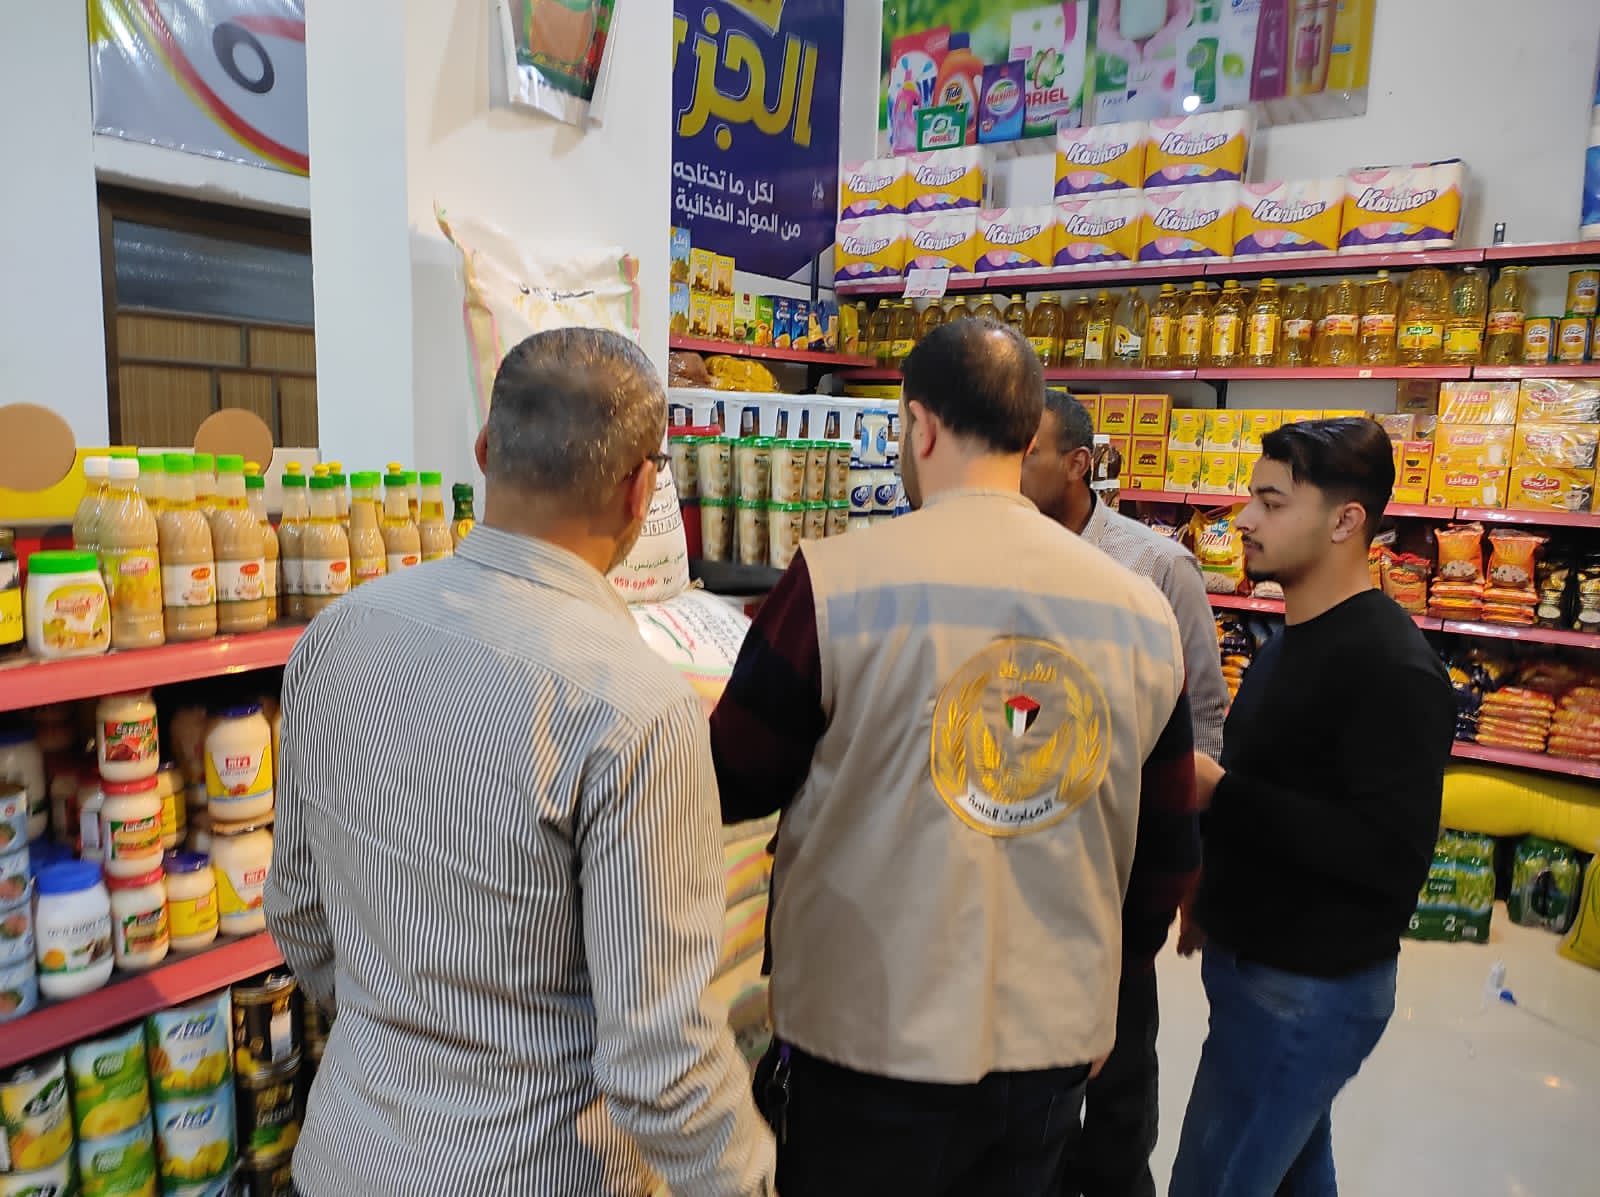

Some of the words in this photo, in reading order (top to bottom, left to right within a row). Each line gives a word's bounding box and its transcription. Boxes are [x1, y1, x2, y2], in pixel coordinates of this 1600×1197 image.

[945, 86, 962, 101] Tide
[1025, 88, 1069, 106] ARIEL
[929, 133, 953, 144] ARIEL
[1160, 132, 1228, 155] Karmen
[1067, 142, 1128, 165] Karmen
[673, 161, 726, 190] تحتاجه
[729, 173, 744, 195] ما
[848, 174, 893, 193] Karmen
[915, 165, 967, 186] Karmen
[748, 180, 774, 205] لكل
[1357, 187, 1437, 213] Karmen
[675, 187, 734, 223] الغذائية
[1251, 199, 1327, 222] Karmen
[737, 206, 778, 235] المواد
[1065, 215, 1126, 237] Karmen
[1153, 207, 1218, 231] Karmen
[781, 220, 800, 241] من
[913, 231, 967, 251] Karmen
[984, 224, 1041, 245] Karmen
[842, 237, 890, 256] Karmen
